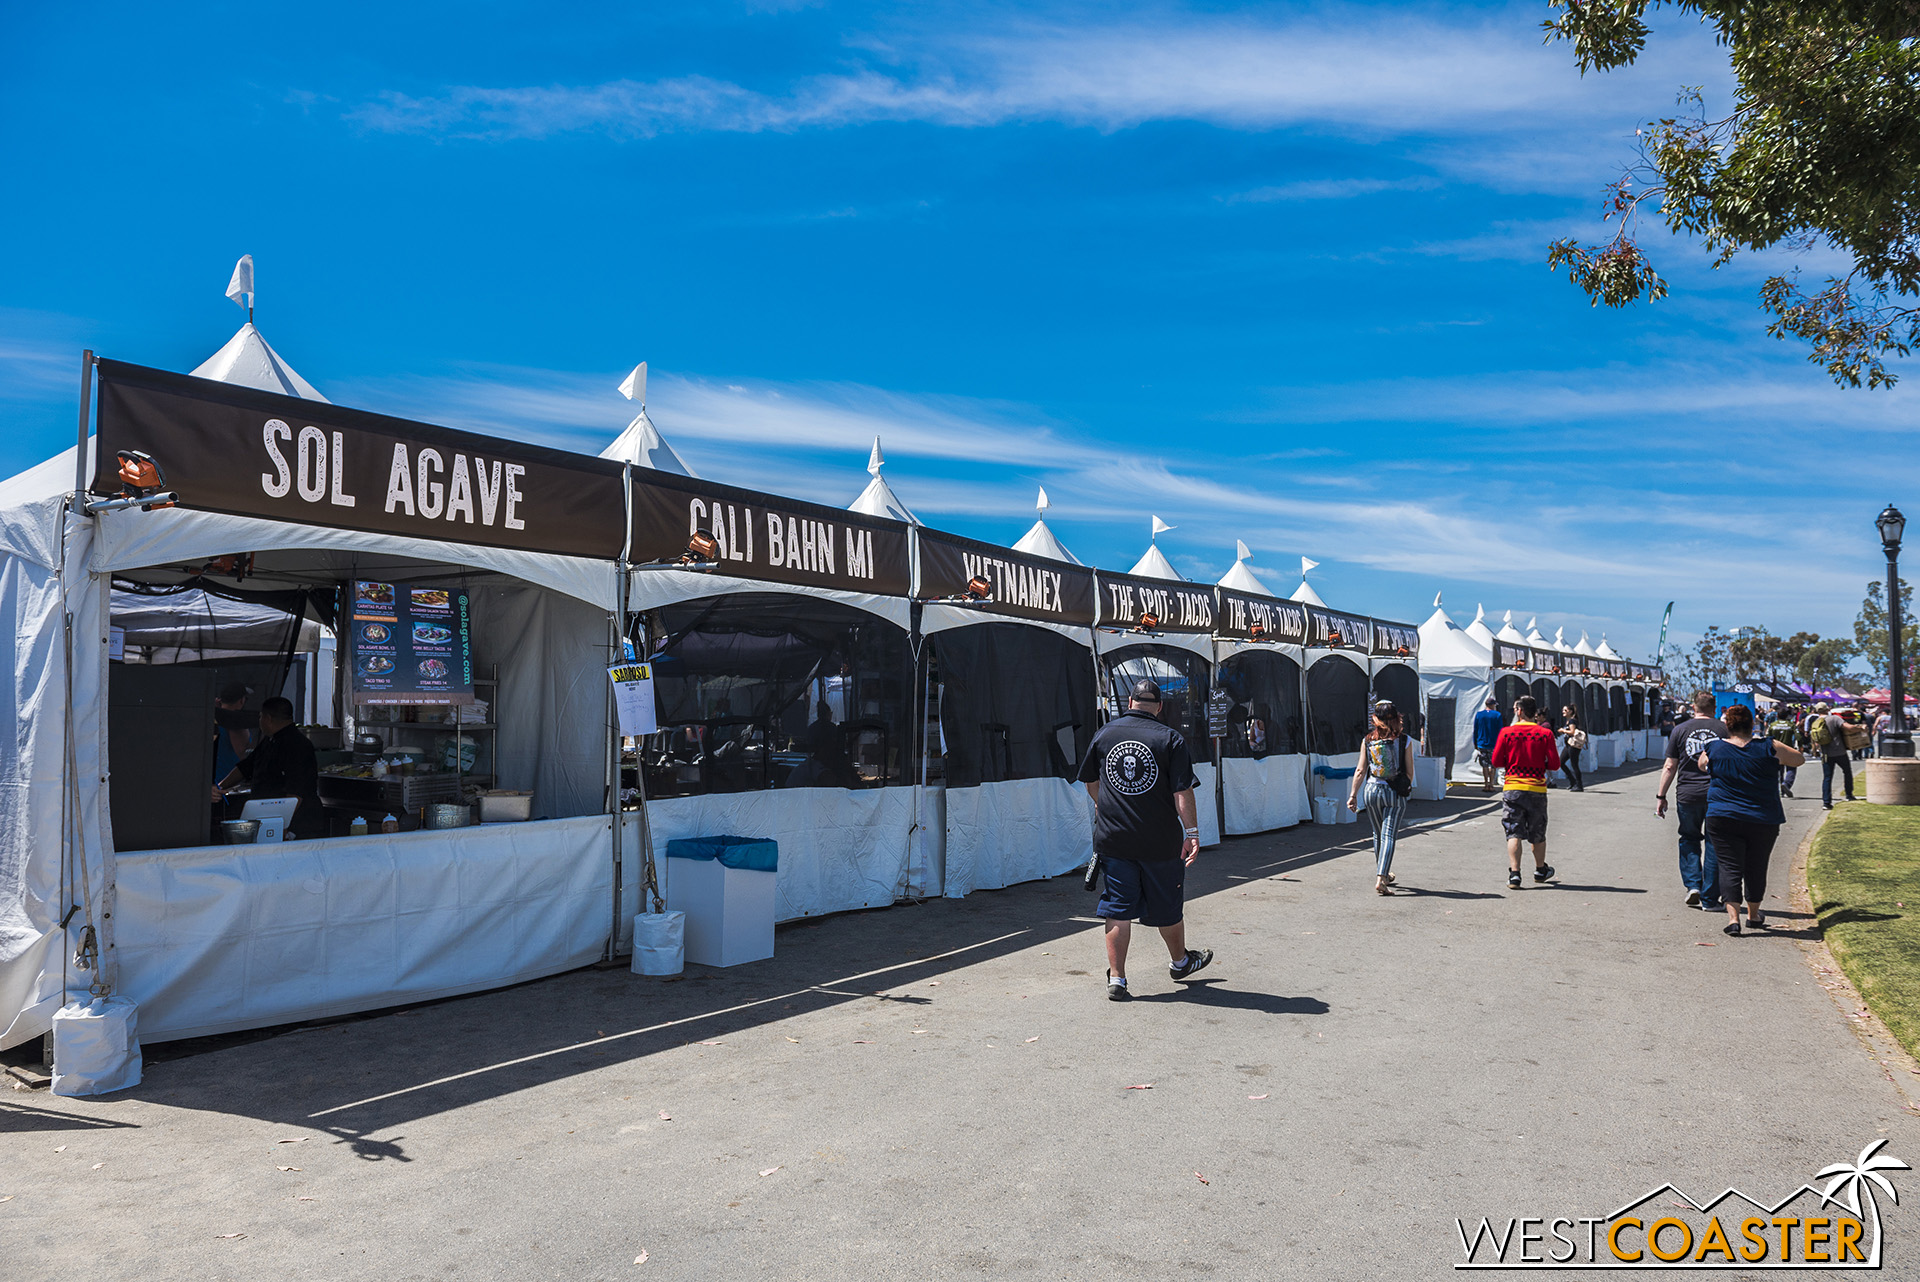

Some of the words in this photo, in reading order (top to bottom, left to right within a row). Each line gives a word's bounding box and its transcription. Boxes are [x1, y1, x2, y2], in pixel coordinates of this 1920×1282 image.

[261, 418, 356, 508] SOL
[384, 442, 526, 531] AGAVE
[689, 497, 753, 563] CALI
[766, 512, 836, 575] BAHN
[846, 527, 875, 580] MI
[1108, 583, 1134, 622] THE
[1139, 586, 1174, 624] SPOT:
[1176, 591, 1212, 627] TACOS
[1227, 597, 1247, 631] THE
[1275, 606, 1302, 638] TACOS
[1313, 613, 1329, 641] THE
[458, 594, 471, 686] @solagave.com
[1734, 683, 1754, 694] 805
